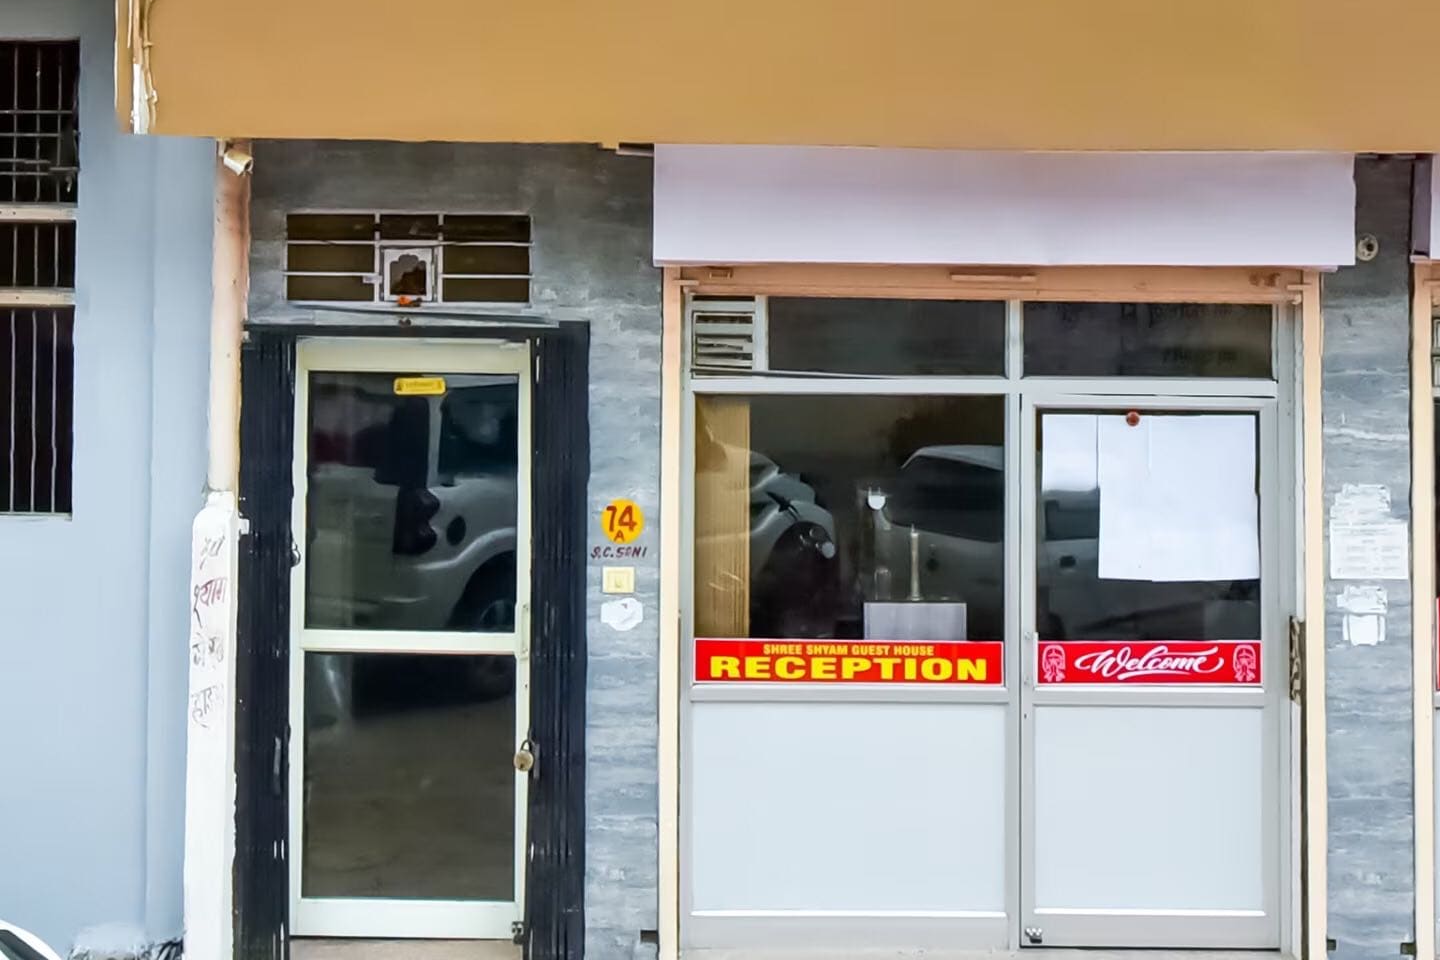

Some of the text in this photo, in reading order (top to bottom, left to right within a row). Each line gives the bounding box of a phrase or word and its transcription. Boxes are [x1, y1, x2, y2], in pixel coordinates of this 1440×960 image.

[606, 505, 637, 532] 74
[613, 530, 625, 542] A
[763, 644, 934, 656] SHREE SHYAM GUEST HOUSE
[1074, 644, 1224, 680] Welcome
[710, 656, 987, 681] RECEPTION
